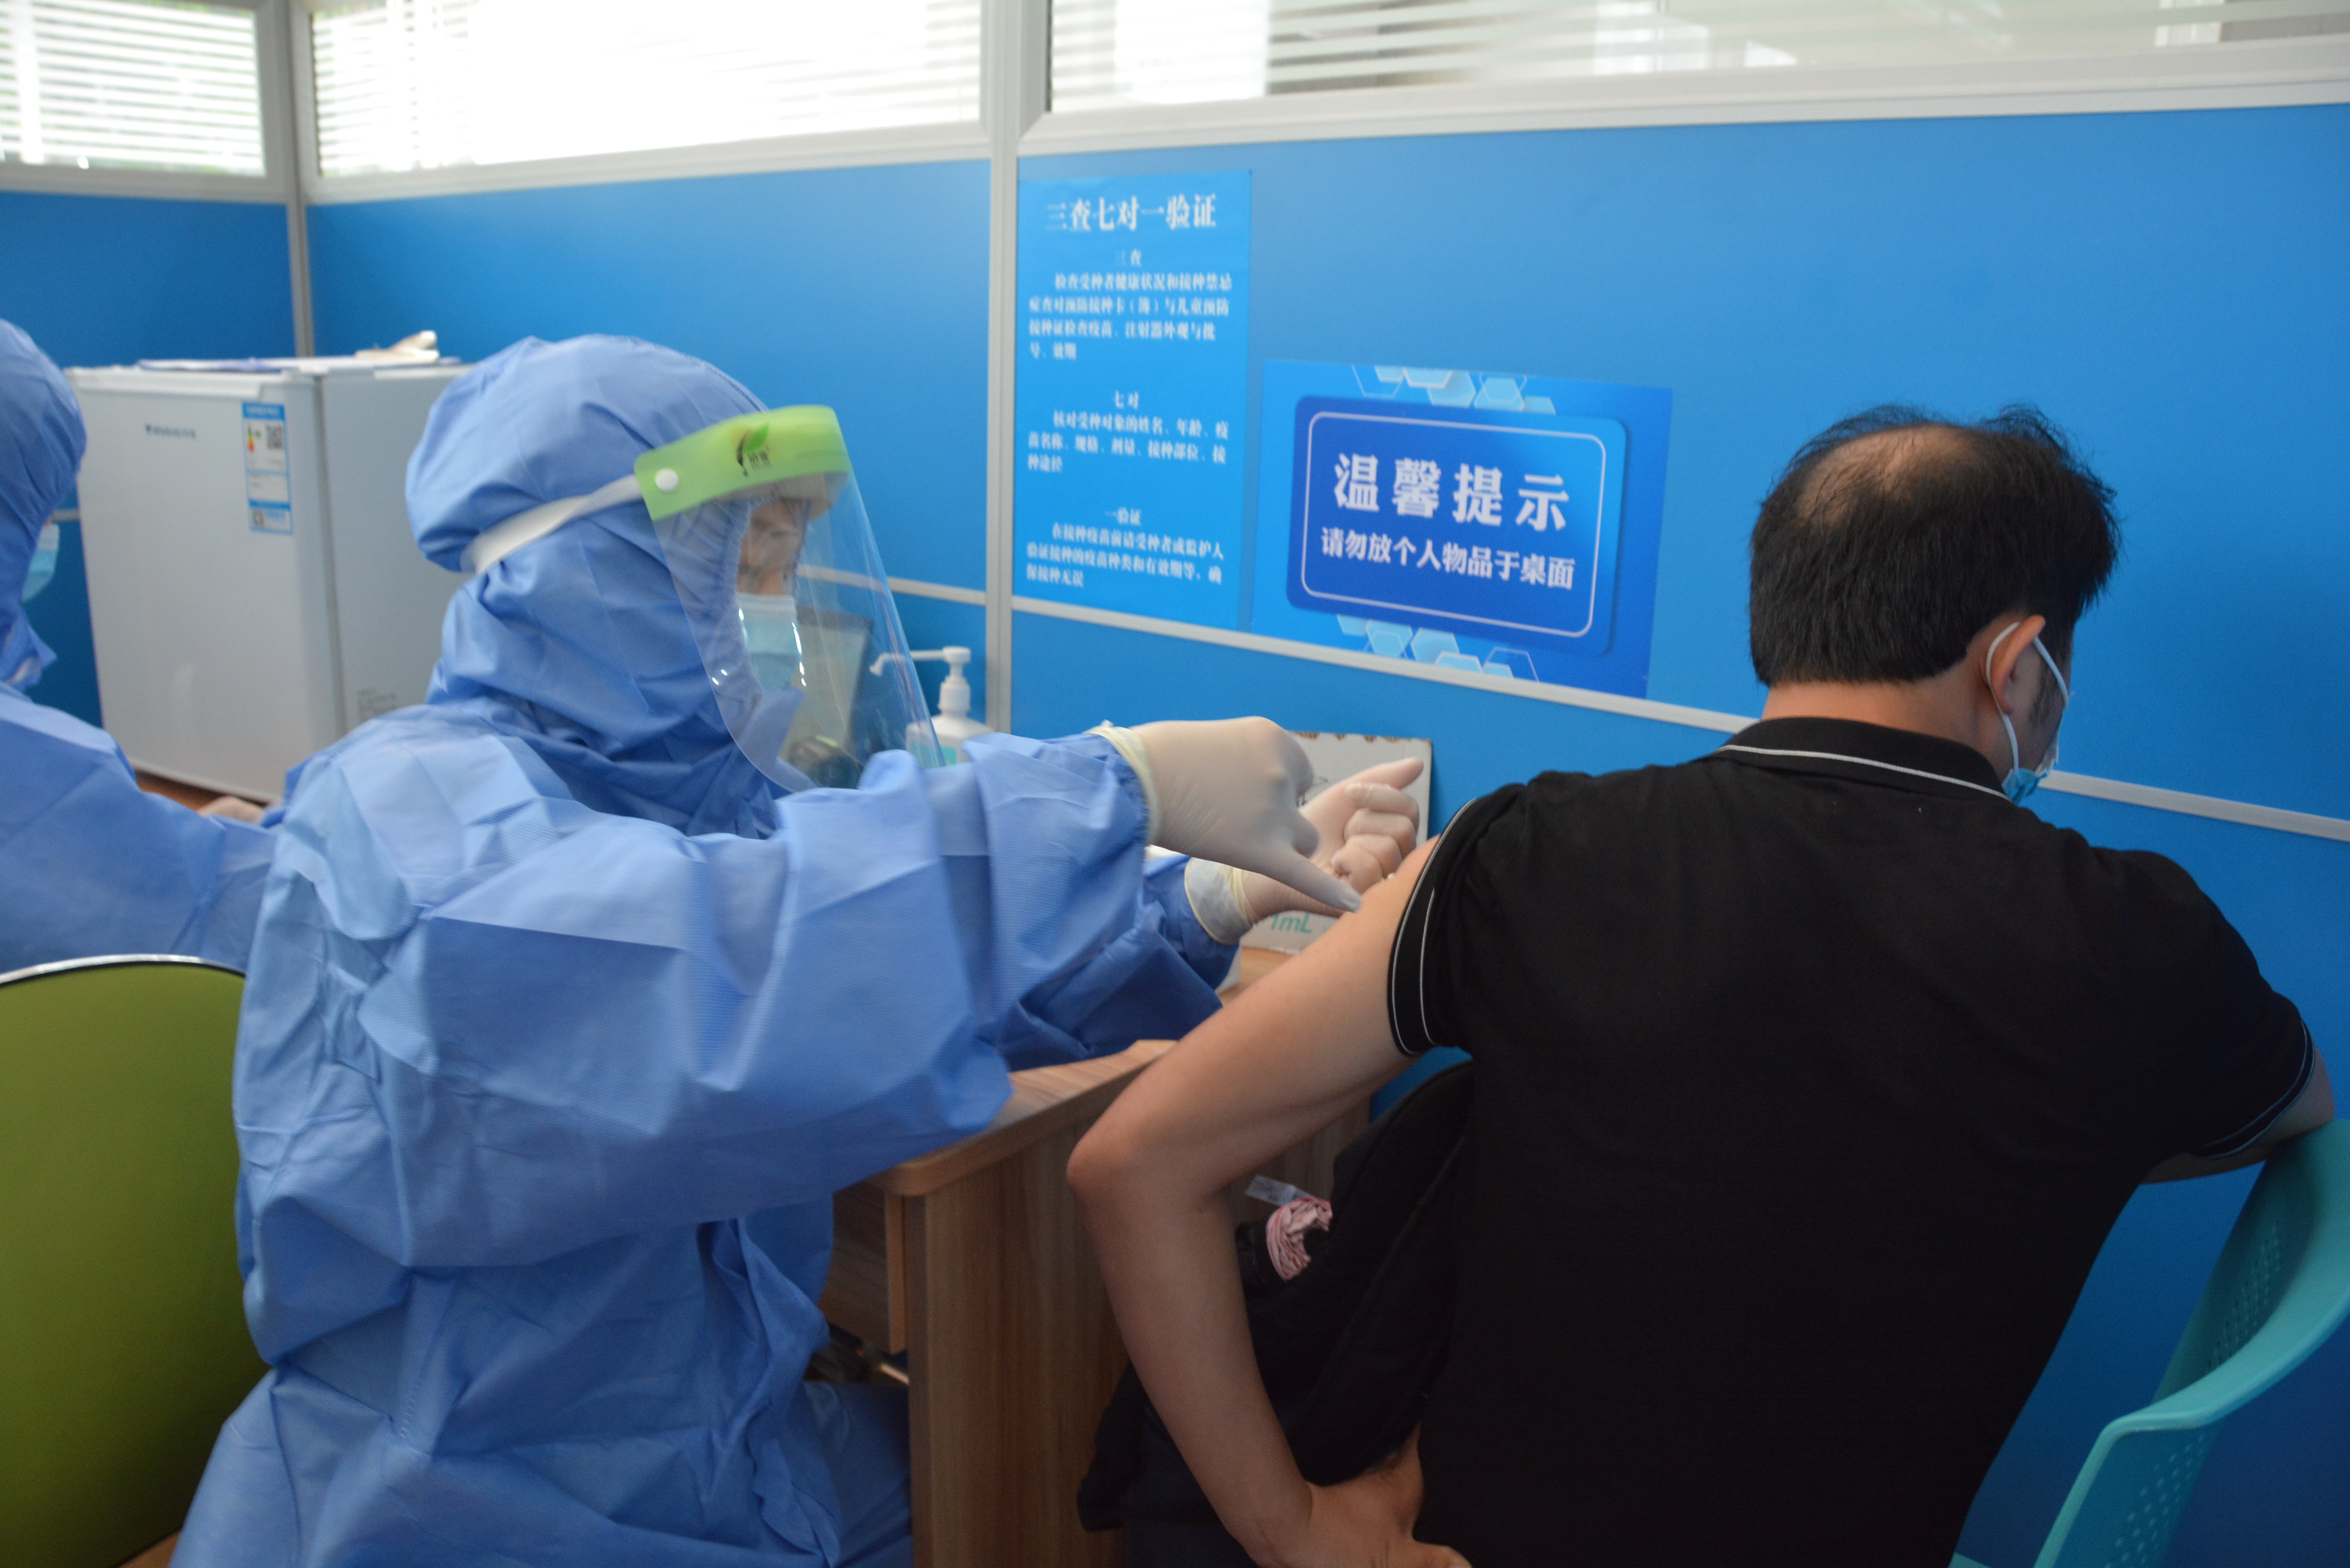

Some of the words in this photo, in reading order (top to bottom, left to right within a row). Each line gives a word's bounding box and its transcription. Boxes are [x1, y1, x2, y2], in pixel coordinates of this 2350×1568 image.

[1045, 193, 1216, 232] 三查七对一验证
[1334, 453, 1569, 532] 温馨提示
[1321, 526, 1575, 591] 请勿放个人物品于桌面
